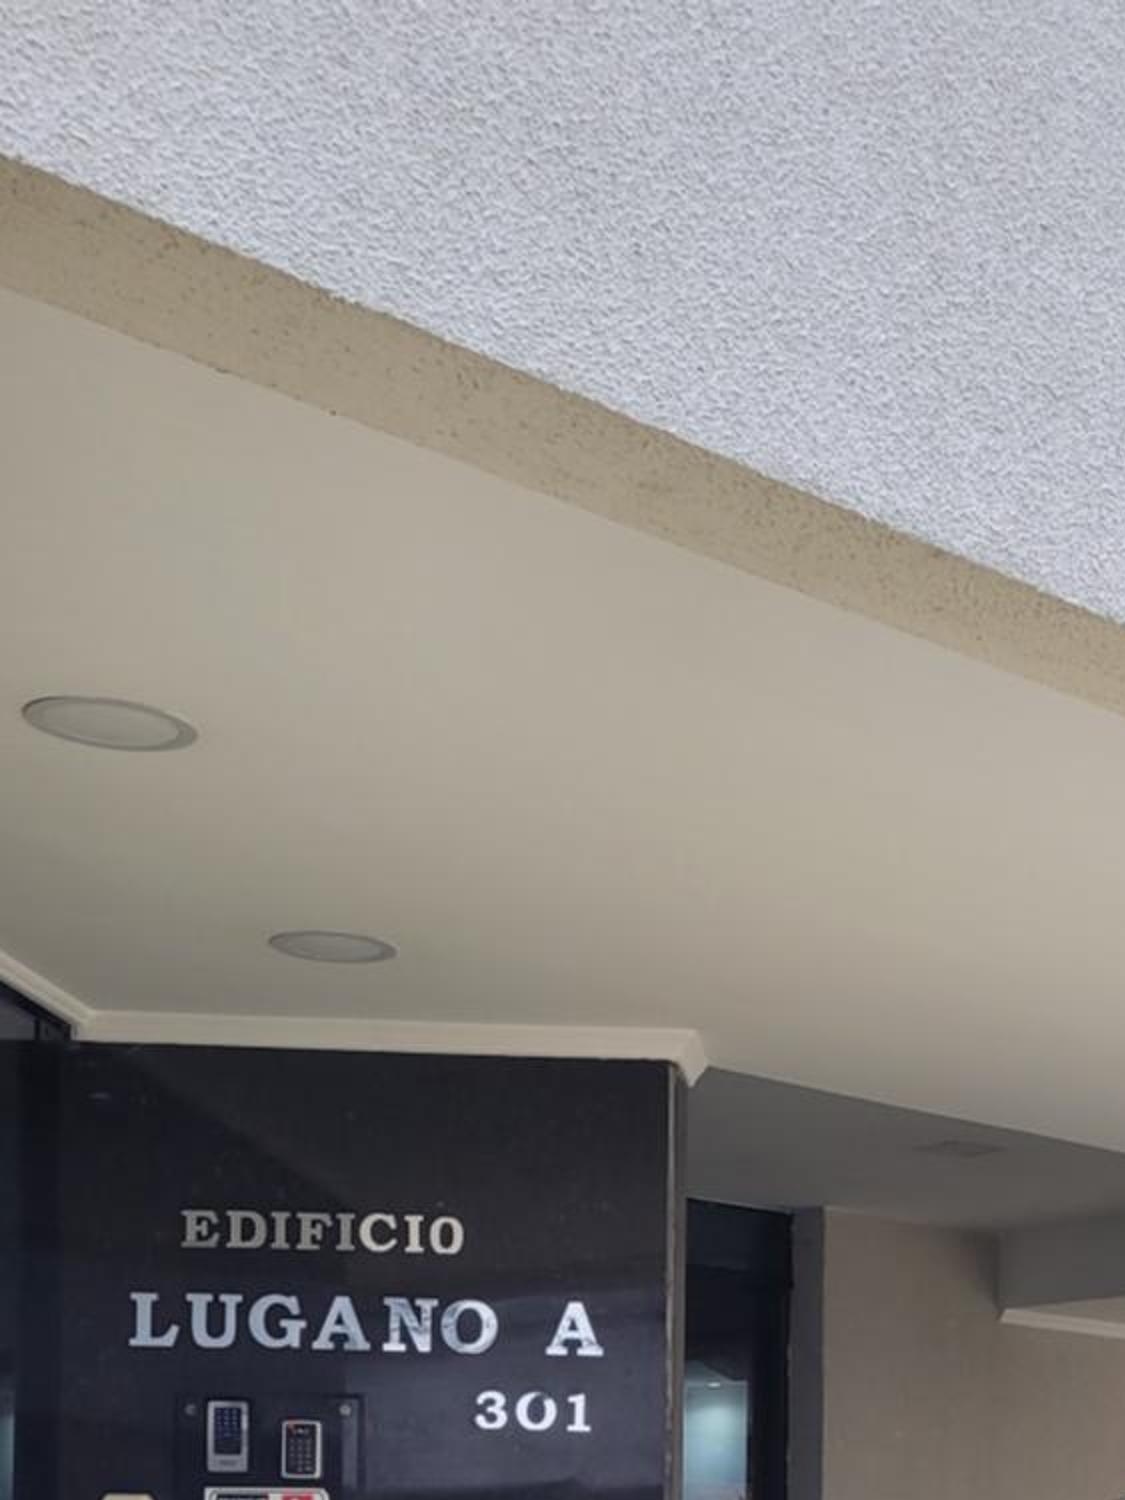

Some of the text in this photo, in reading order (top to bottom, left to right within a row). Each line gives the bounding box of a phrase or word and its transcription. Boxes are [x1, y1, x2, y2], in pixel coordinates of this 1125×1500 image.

[180, 1209, 465, 1255] EDIFICIO
[128, 1292, 604, 1357] LUGANO A
[474, 1390, 592, 1433] 301
